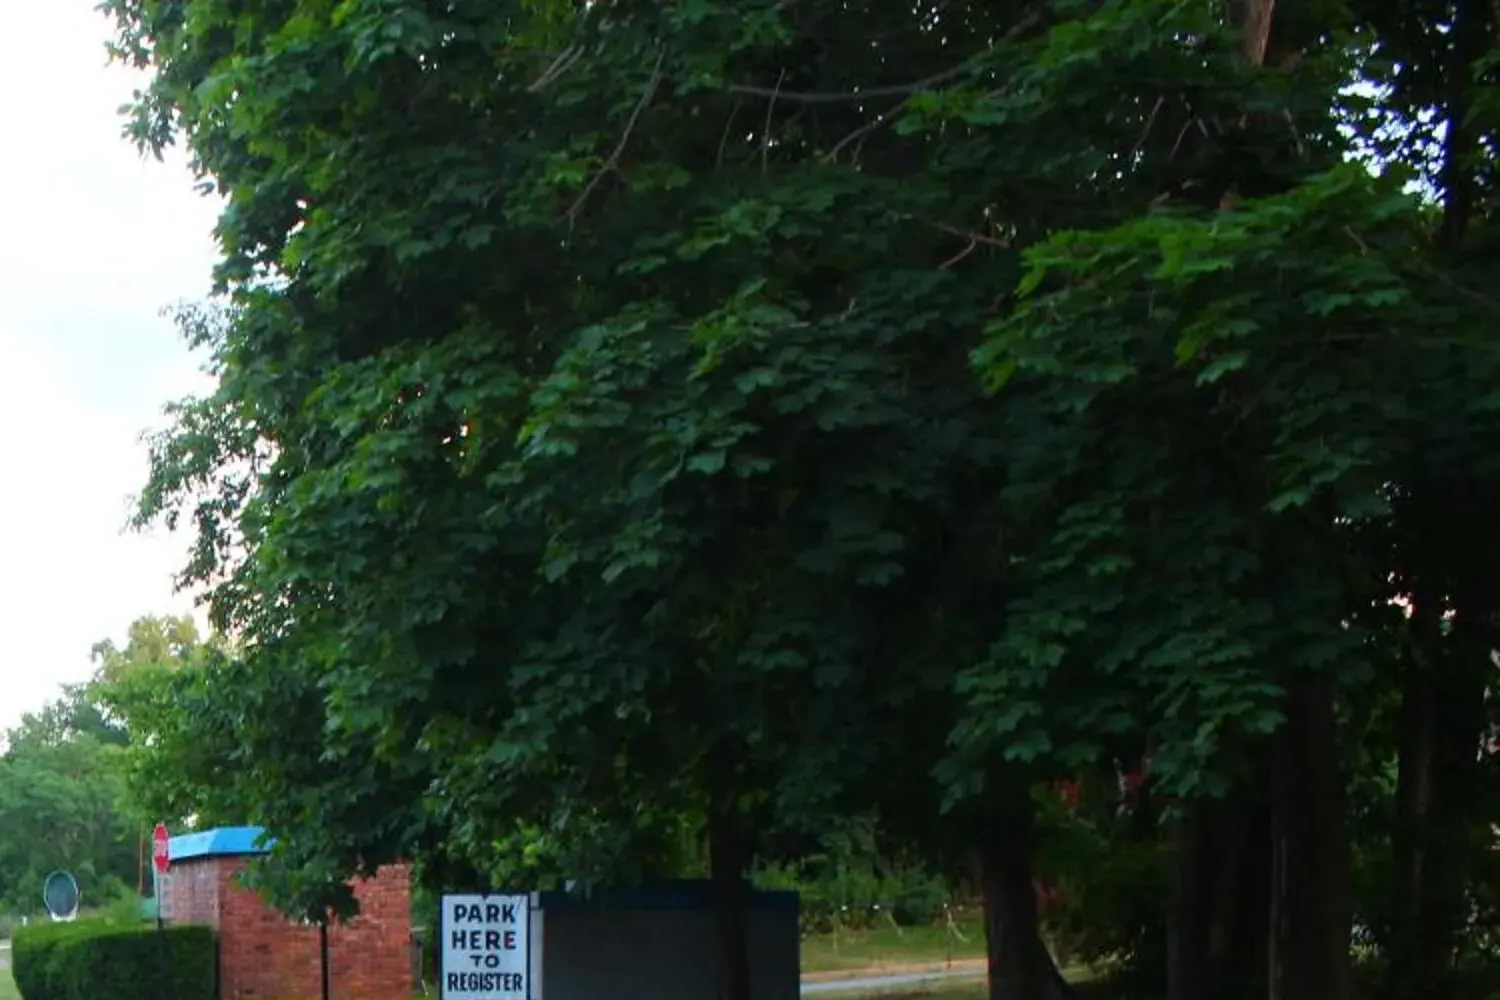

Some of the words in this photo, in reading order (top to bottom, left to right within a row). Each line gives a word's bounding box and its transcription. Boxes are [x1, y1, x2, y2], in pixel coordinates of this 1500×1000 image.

[453, 904, 515, 923] PARK
[452, 930, 517, 950] HERE
[469, 955, 500, 968] TO
[447, 972, 523, 992] REGISTER
